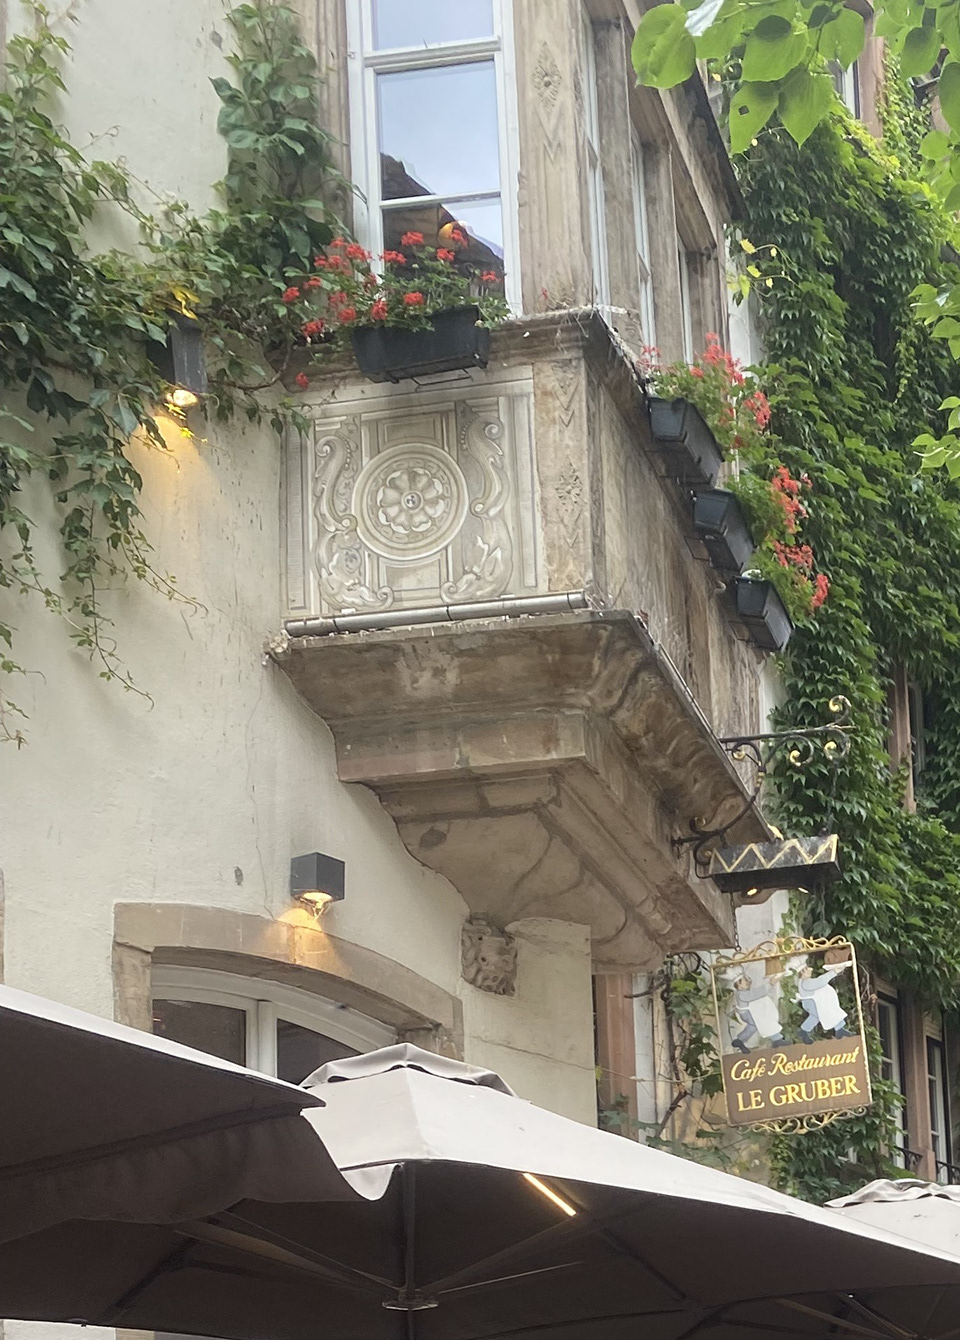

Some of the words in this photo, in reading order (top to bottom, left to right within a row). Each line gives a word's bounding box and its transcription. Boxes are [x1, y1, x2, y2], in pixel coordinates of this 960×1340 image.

[730, 1057, 766, 1083] Café
[767, 1046, 860, 1076] Restaurant
[736, 1089, 765, 1112] LE
[769, 1074, 861, 1107] GRUBER
